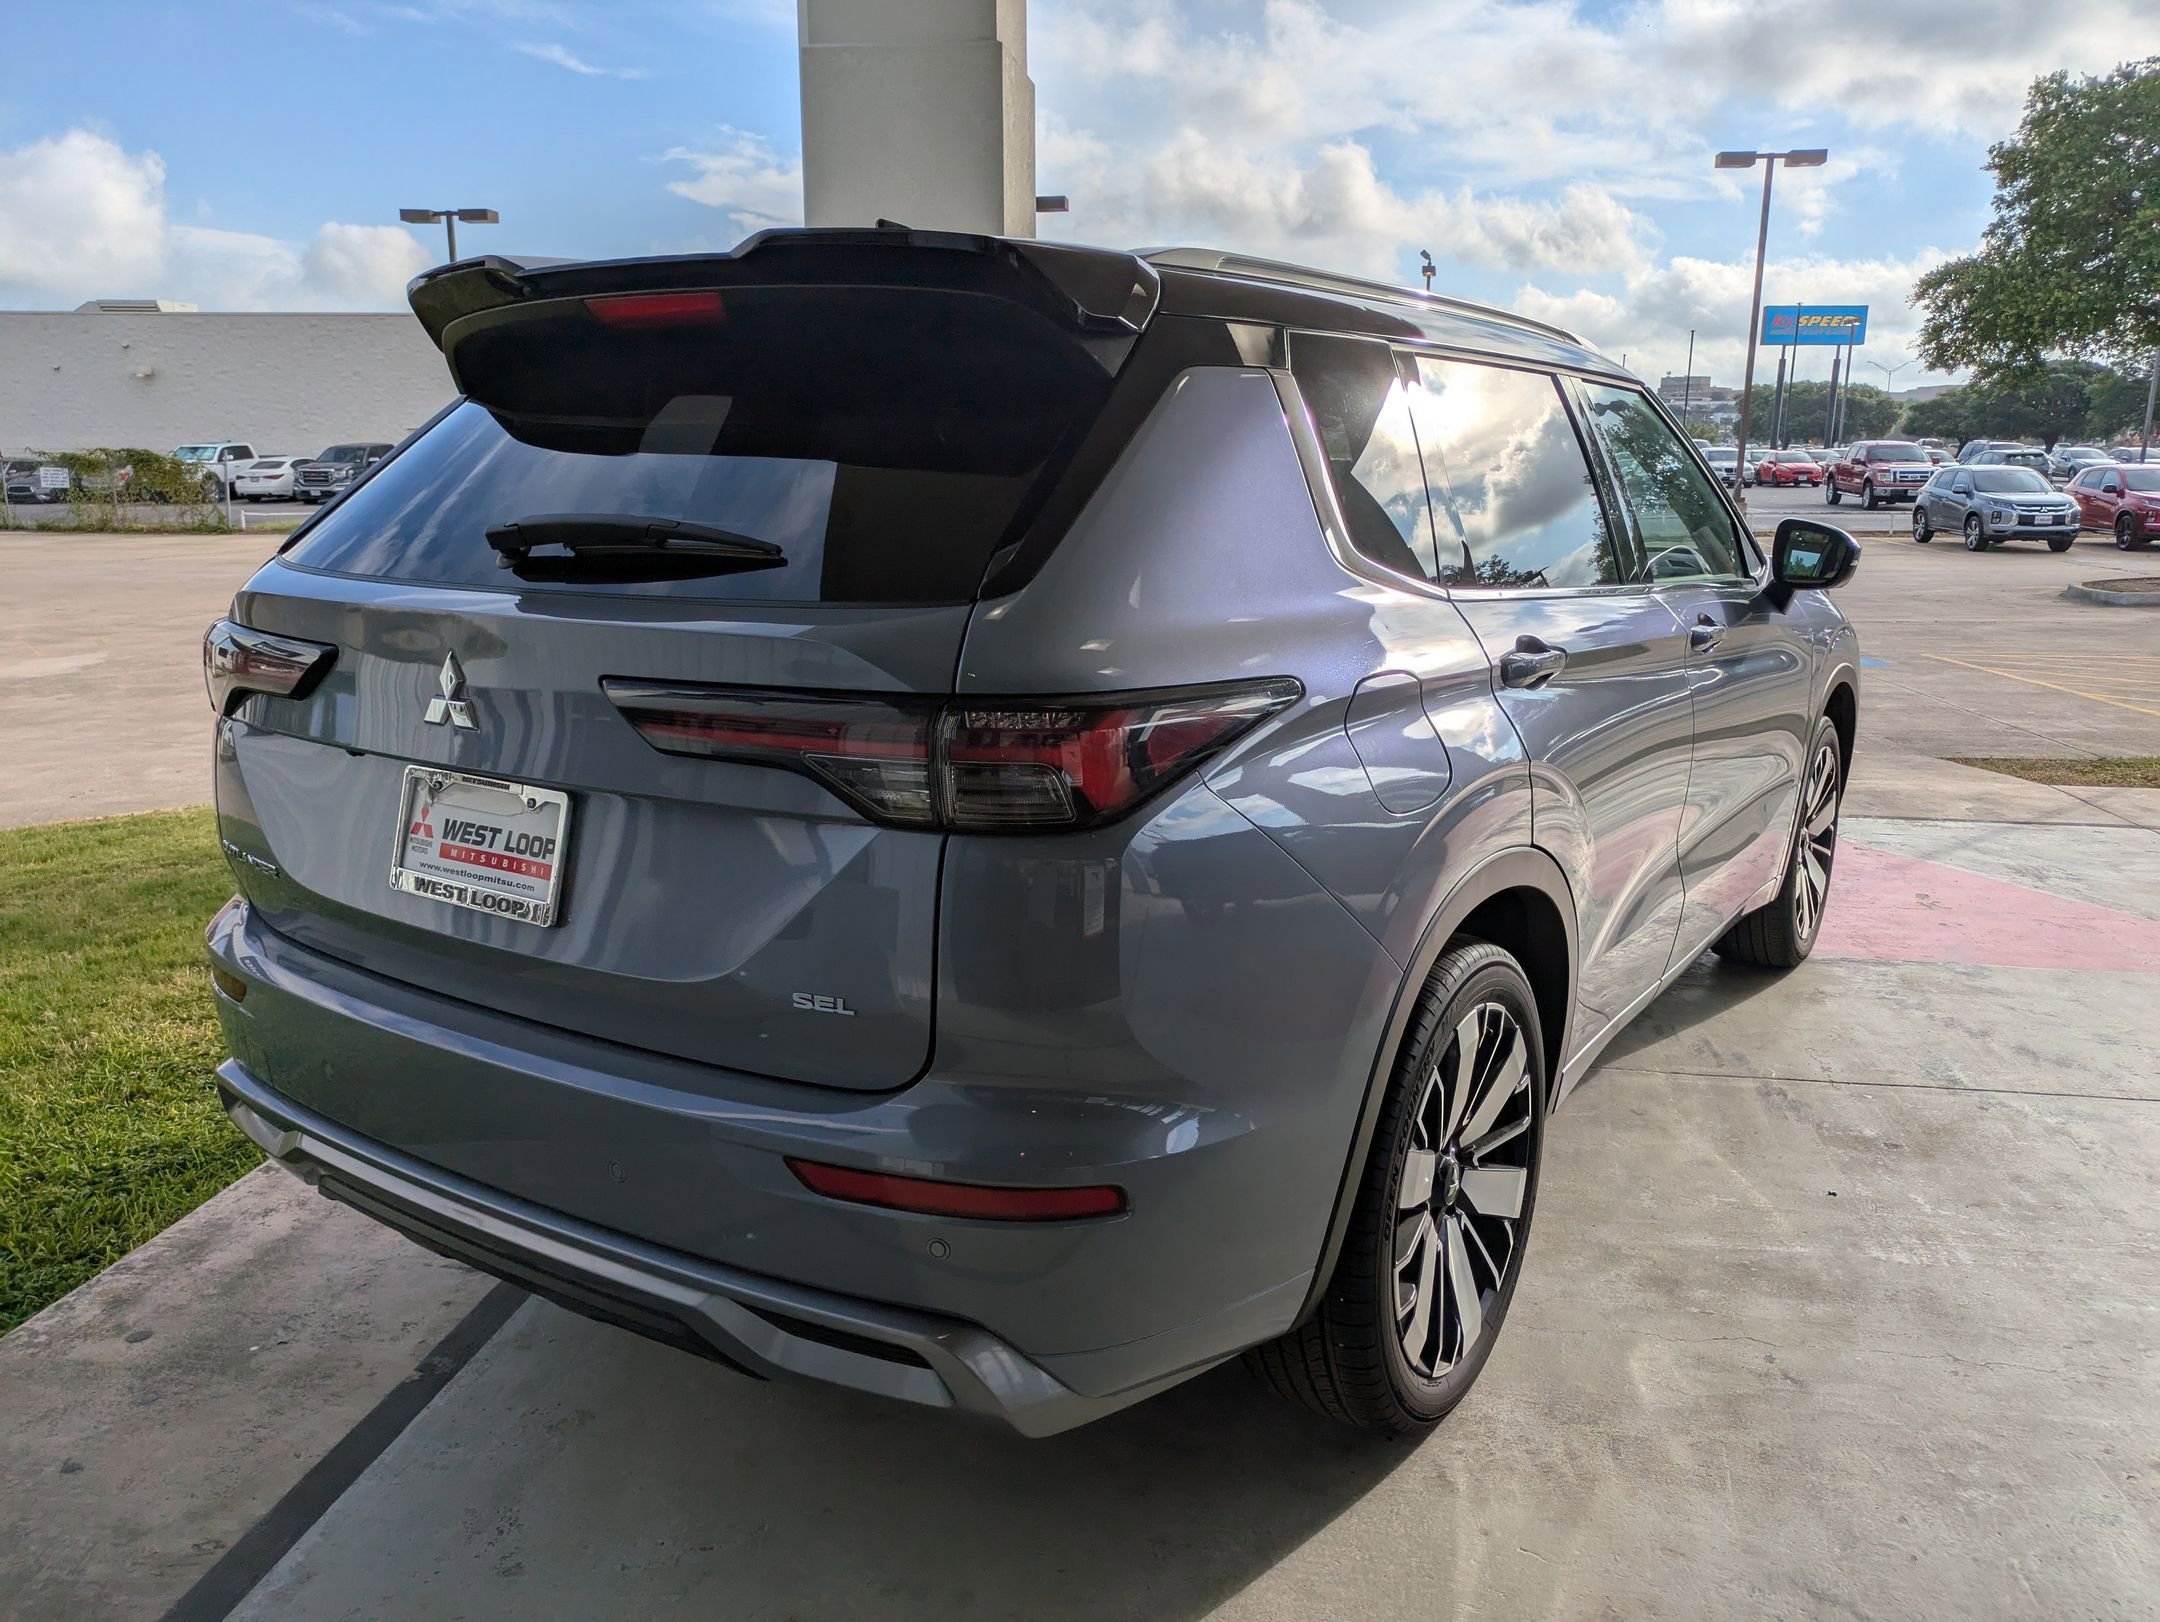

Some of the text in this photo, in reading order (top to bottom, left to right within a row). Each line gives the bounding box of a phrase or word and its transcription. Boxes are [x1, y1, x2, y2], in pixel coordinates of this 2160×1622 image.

[442, 818, 556, 860] WEST LOOP
[419, 861, 535, 892] www.westloopmitsu.com
[450, 848, 545, 876] MITSUBISHI
[413, 875, 526, 916] WEST LOOP
[792, 992, 855, 1016] SEL
[1385, 1038, 1435, 1240] OPEN COUNTRY
